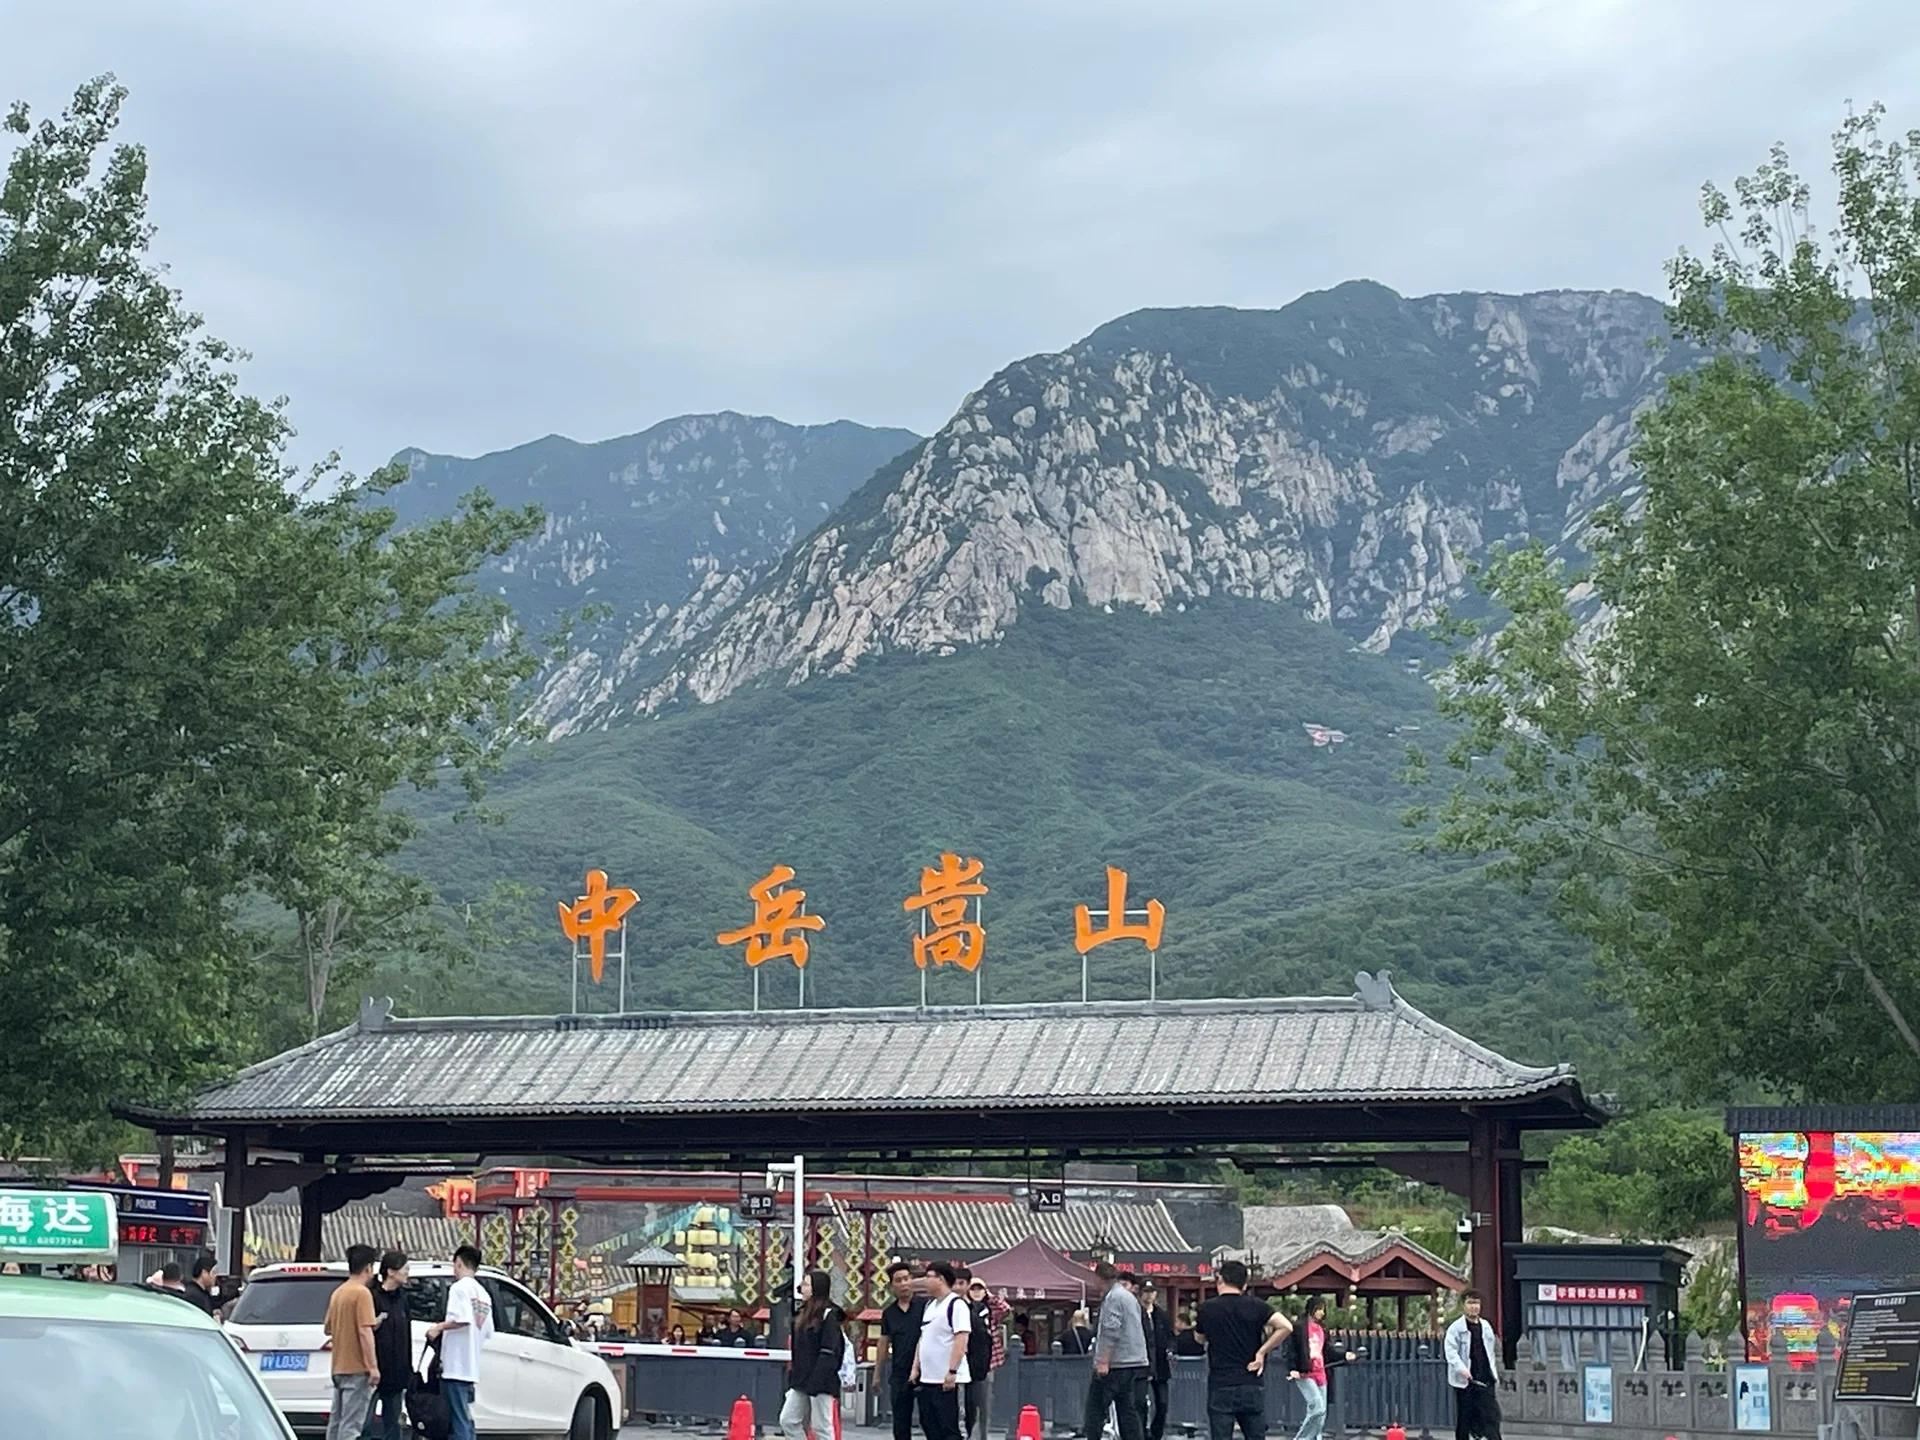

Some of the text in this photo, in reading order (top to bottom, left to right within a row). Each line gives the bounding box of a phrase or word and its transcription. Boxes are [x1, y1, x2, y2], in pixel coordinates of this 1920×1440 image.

[557, 851, 1166, 983] 中岳嵩山
[135, 1198, 157, 1210] POLICE
[750, 1196, 772, 1208] 出口
[1039, 1192, 1061, 1204] 入口
